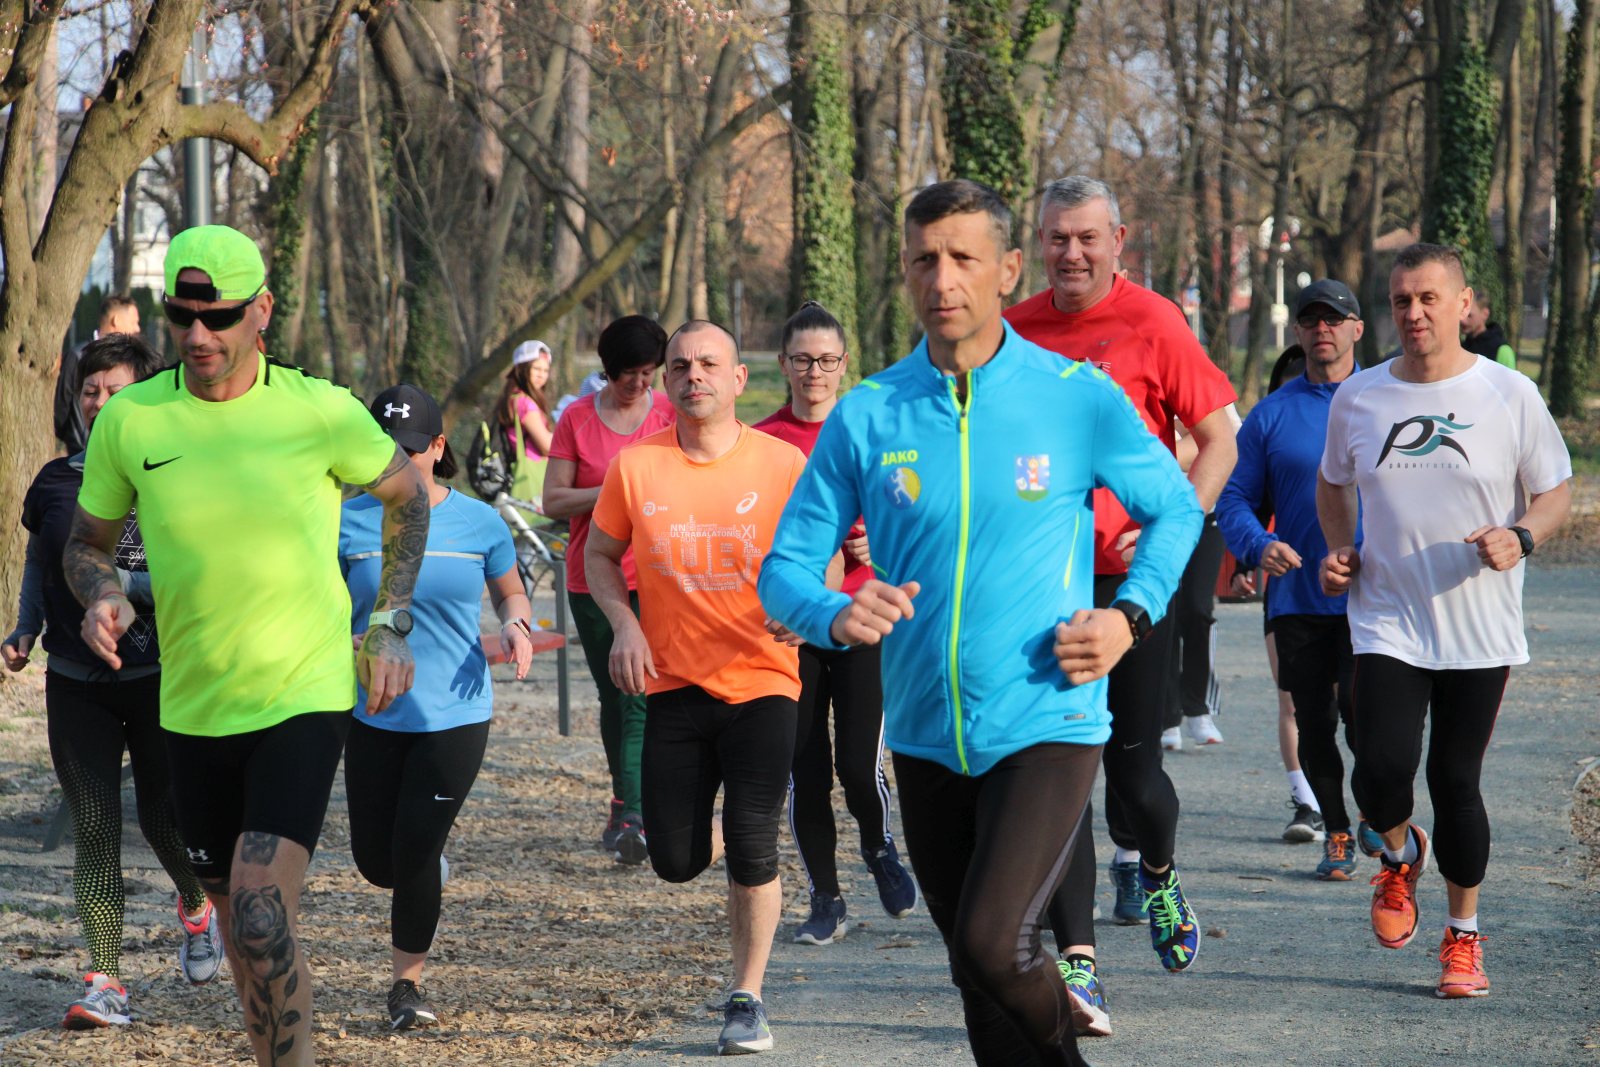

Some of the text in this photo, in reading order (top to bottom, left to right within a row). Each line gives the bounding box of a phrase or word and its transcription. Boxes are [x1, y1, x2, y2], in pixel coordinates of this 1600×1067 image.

[881, 450, 918, 466] JAKO
[670, 524, 686, 532] NN
[741, 524, 756, 539] XI
